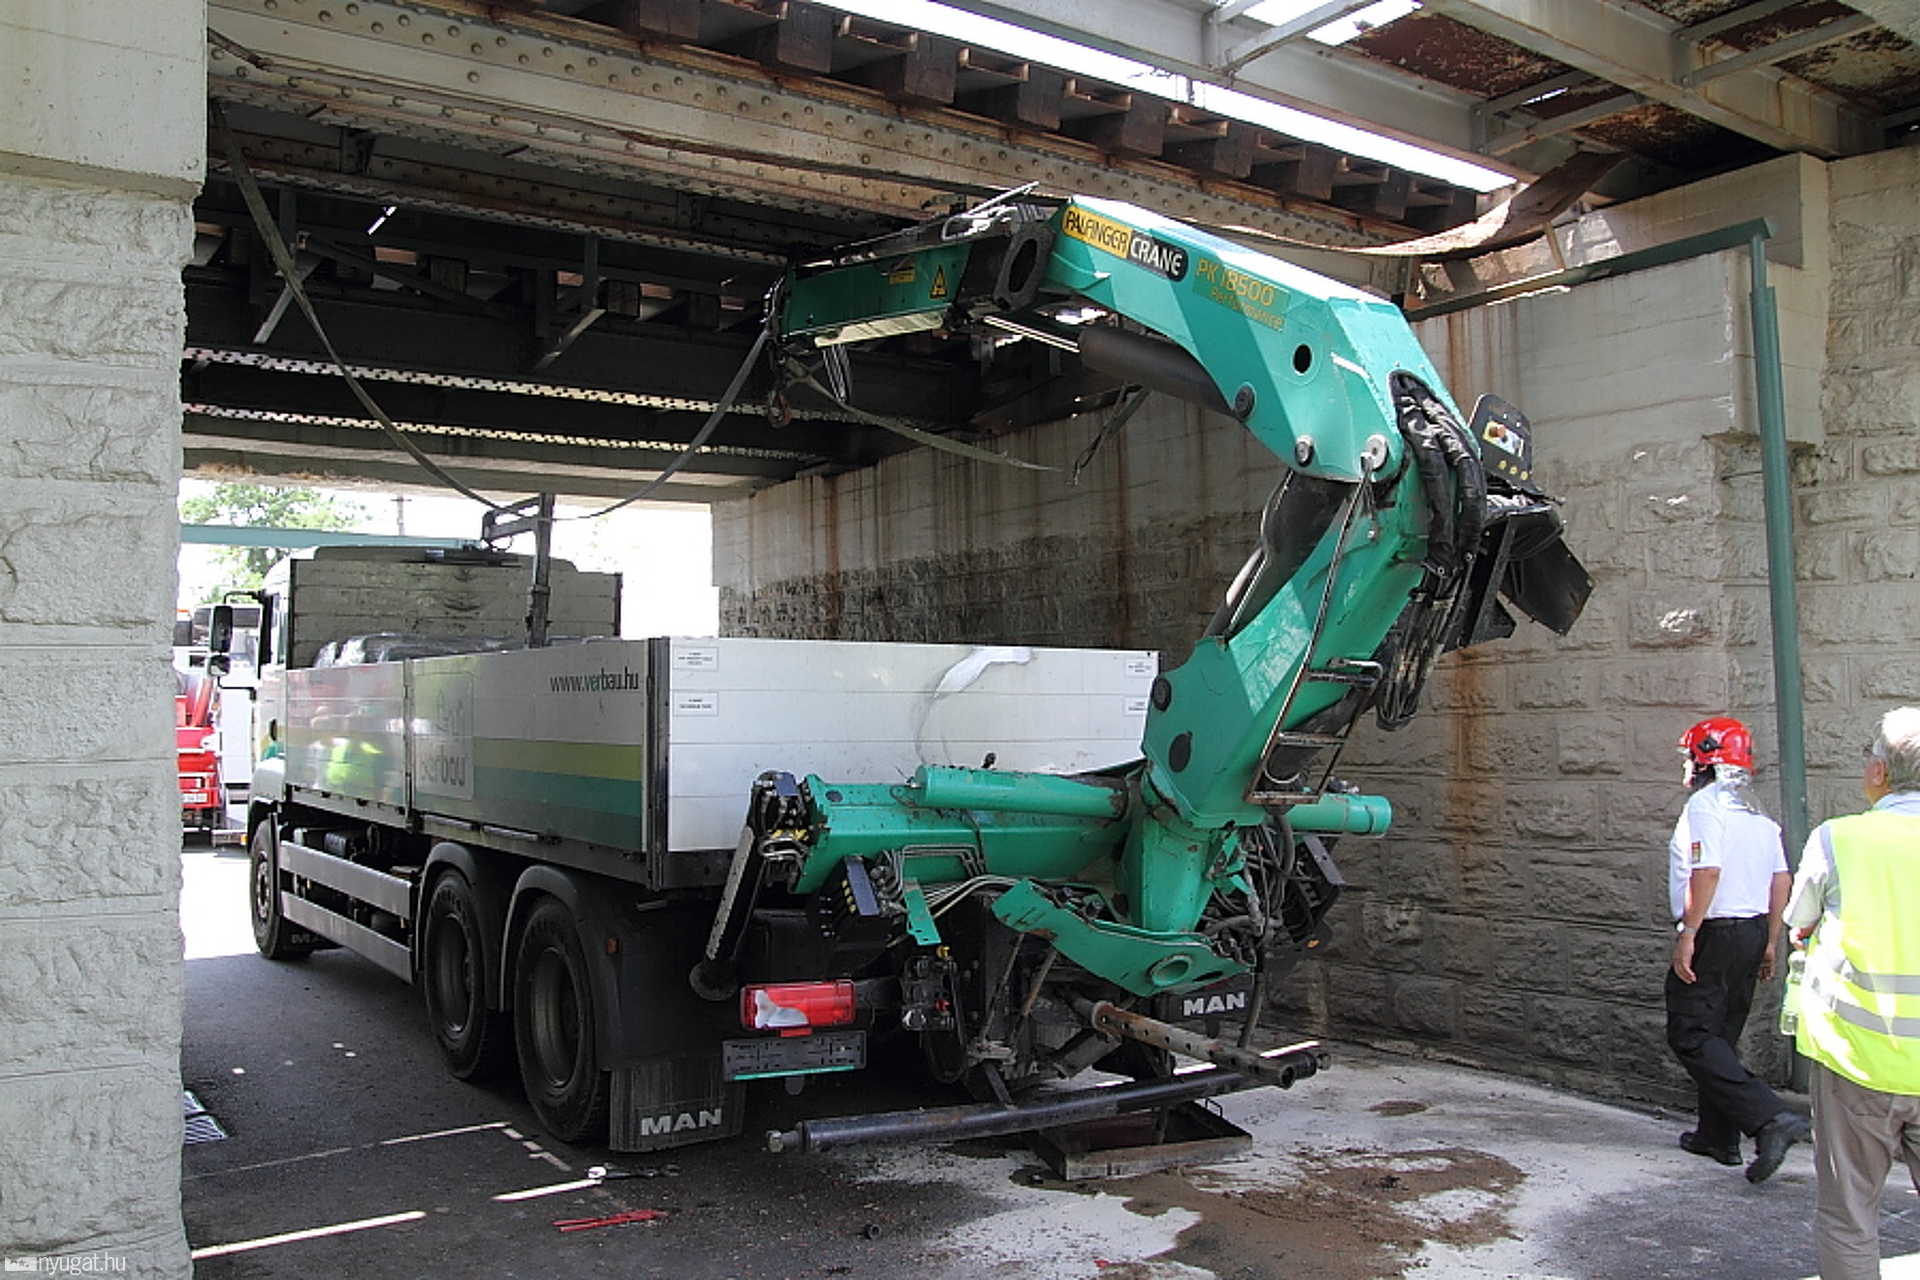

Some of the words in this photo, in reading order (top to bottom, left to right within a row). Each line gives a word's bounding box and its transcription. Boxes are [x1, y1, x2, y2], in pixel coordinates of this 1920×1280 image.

[1065, 209, 1129, 251] PALFINGER
[1130, 237, 1183, 276] CRANE
[1197, 258, 1219, 283] PK
[1221, 267, 1275, 307] 18500
[1183, 992, 1245, 1016] MAN
[640, 1108, 722, 1136] MAN
